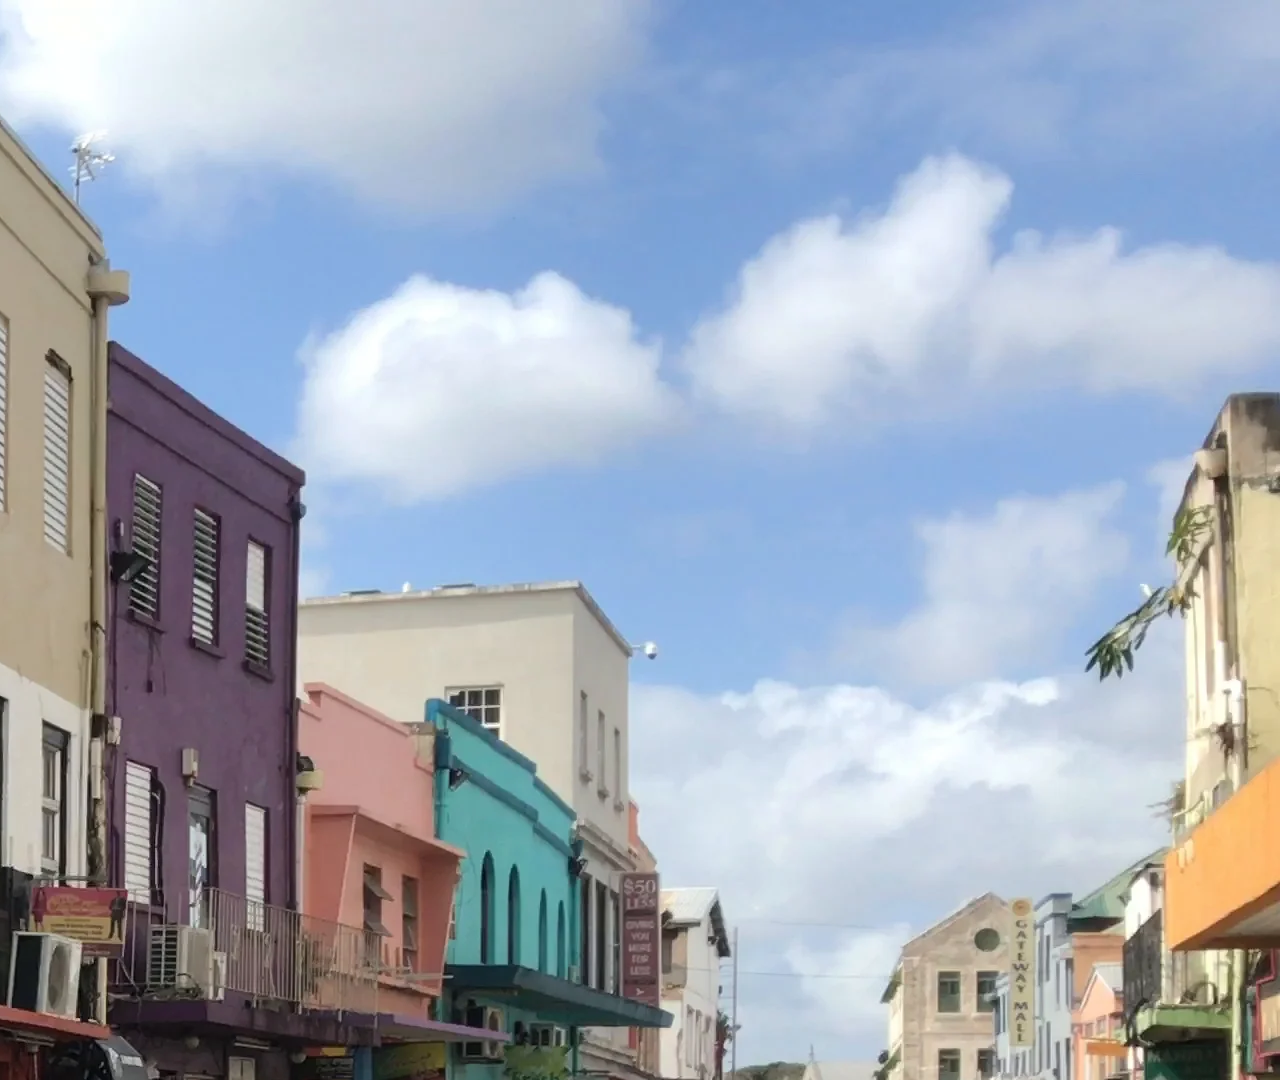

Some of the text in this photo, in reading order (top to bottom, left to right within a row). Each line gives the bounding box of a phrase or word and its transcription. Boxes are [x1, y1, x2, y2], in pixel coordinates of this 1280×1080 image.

[623, 878, 657, 896] $50
[1012, 919, 1030, 1042] GATEWAY MALL
